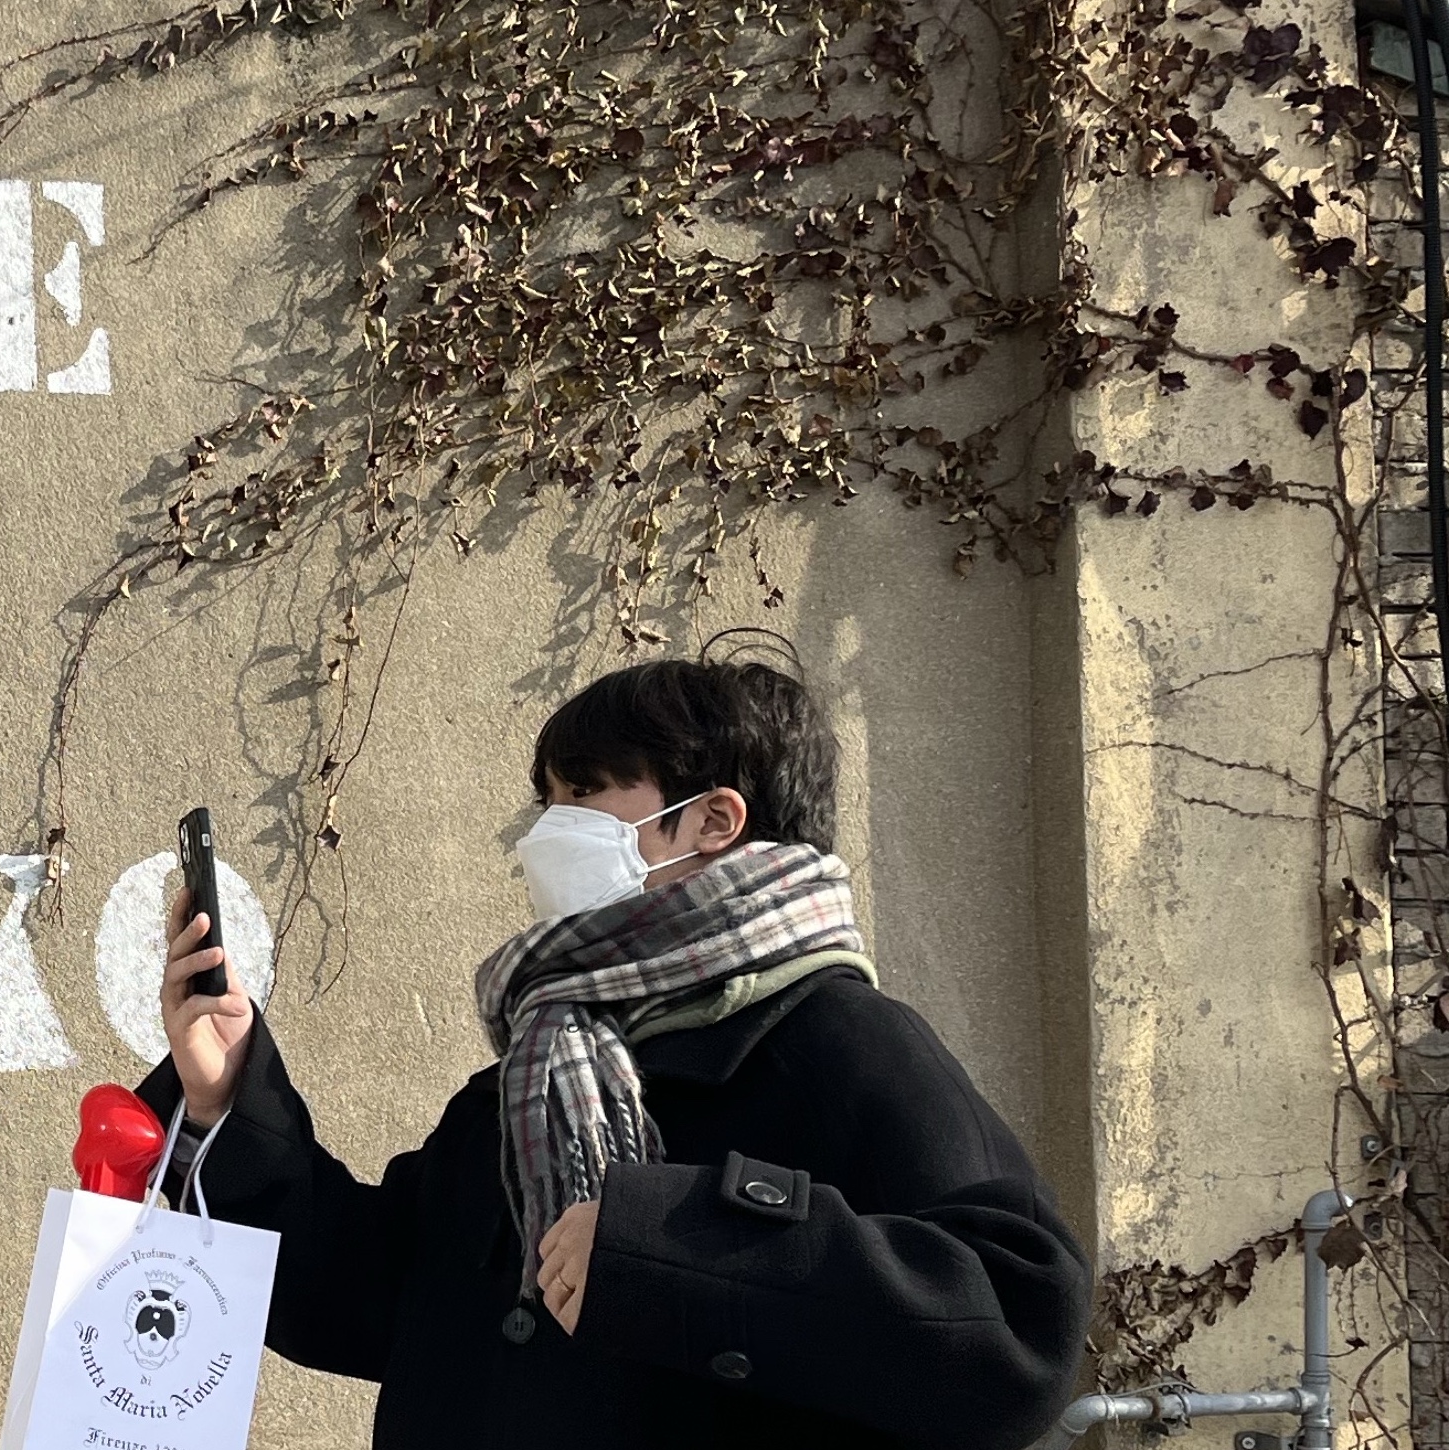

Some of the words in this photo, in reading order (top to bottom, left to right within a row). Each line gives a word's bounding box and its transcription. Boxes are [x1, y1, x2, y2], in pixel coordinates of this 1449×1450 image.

[74, 1320, 106, 1388] Santa
[101, 1386, 168, 1419] Maria
[169, 1352, 233, 1421] Novella
